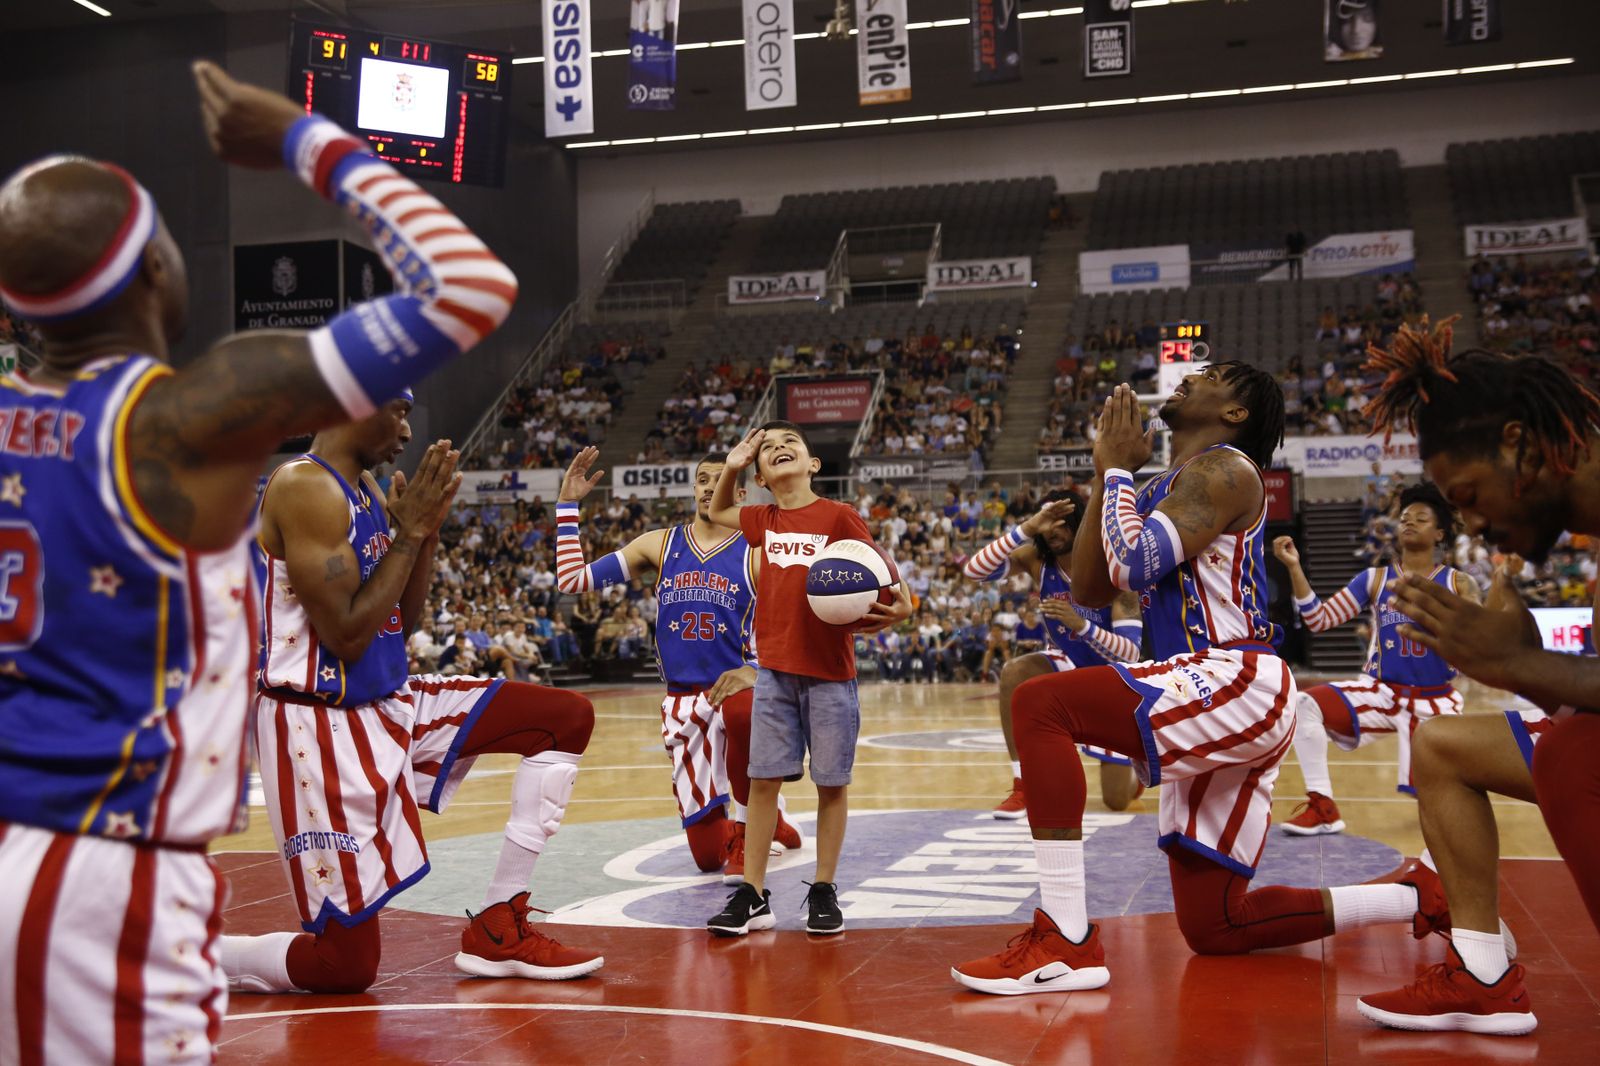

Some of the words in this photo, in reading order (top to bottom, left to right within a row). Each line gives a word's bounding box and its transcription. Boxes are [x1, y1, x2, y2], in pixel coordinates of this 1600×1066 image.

[323, 40, 346, 59] 91
[370, 42, 379, 56] 4
[553, 0, 581, 89] sisa
[757, 2, 788, 102] otero
[866, 13, 907, 87] enPie
[476, 62, 498, 81] 58
[1474, 225, 1579, 247] IDEAL
[934, 262, 1025, 284] IDEAL
[734, 275, 820, 296] IDEAL
[241, 298, 334, 313] AYUNTAMIENTO
[249, 317, 264, 328] DE
[267, 313, 325, 328] GRANADA
[1161, 342, 1191, 363] 24
[792, 386, 867, 397] AYUNTAMIENTO
[1306, 447, 1364, 461] RADIO
[623, 467, 689, 486] asisa
[859, 464, 913, 483] gamo
[674, 570, 729, 594] HARLEM
[662, 588, 737, 611] GLOBETROTTERS
[681, 611, 715, 641] 25
[284, 830, 360, 861] GLOBETROTTERS
